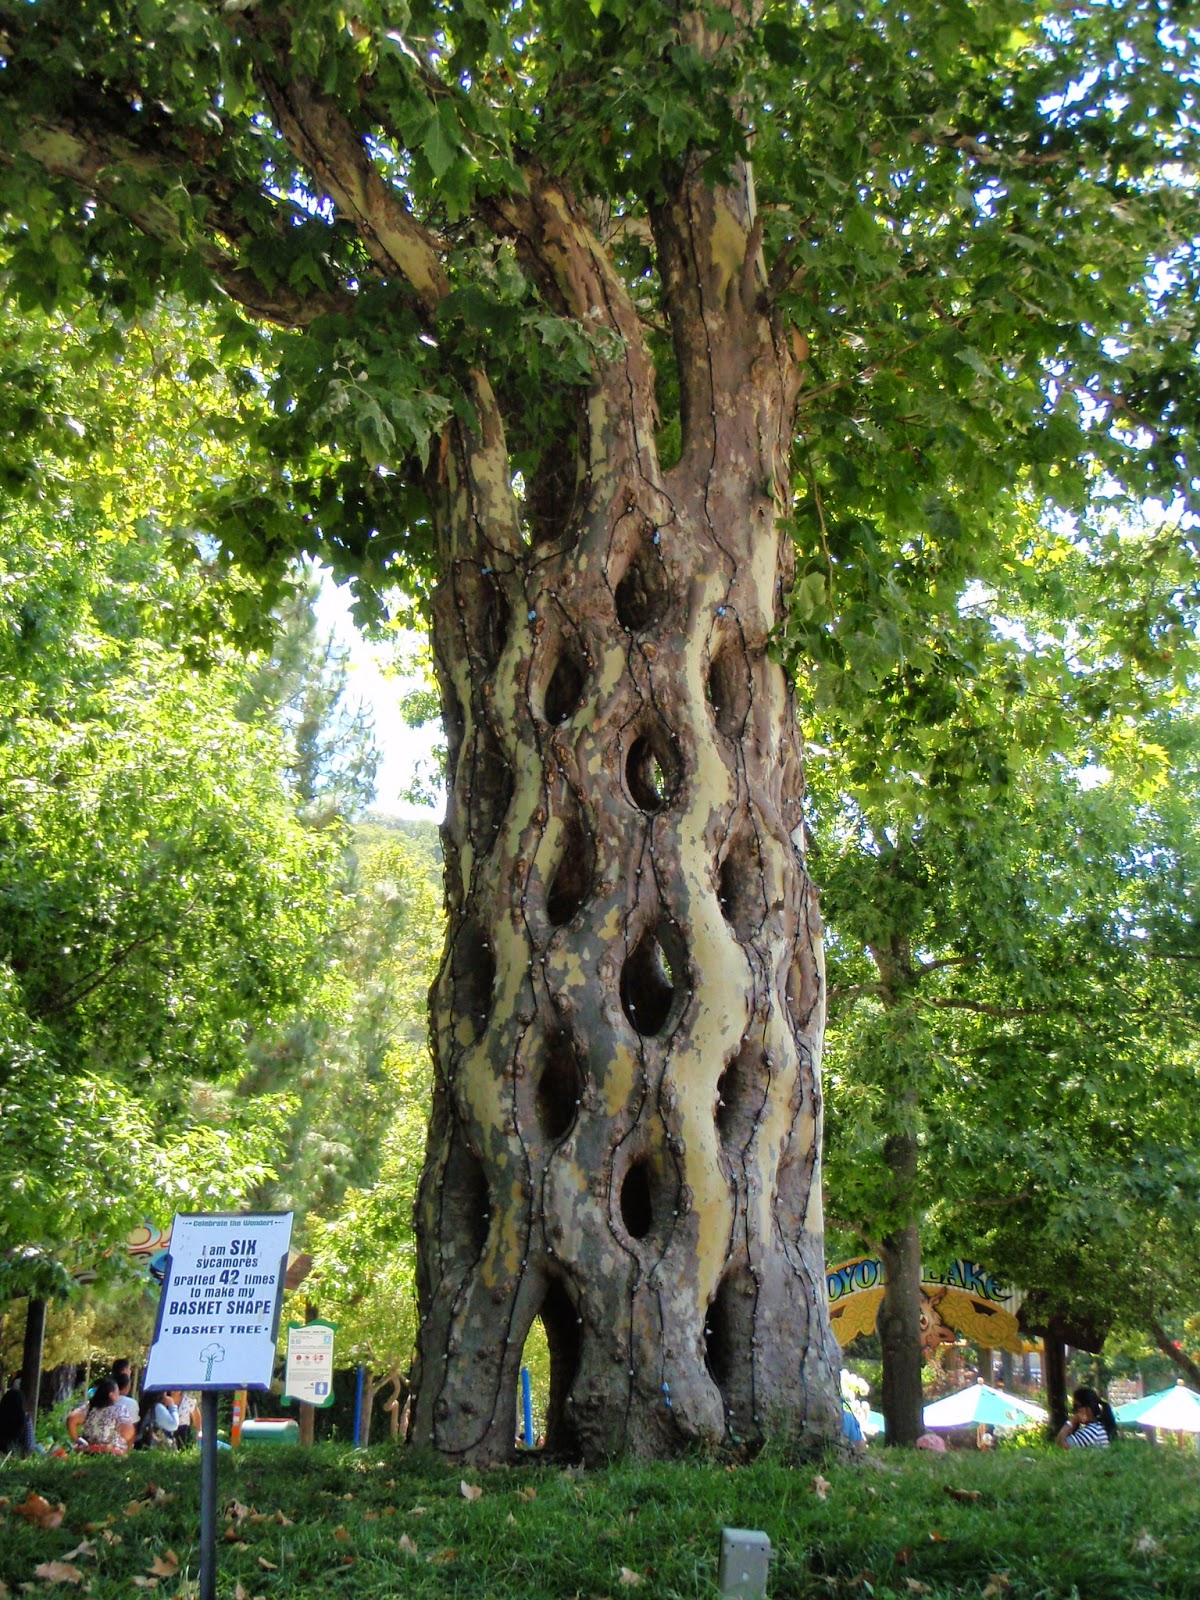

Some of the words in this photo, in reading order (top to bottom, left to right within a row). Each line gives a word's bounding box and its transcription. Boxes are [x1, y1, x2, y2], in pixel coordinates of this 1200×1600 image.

[209, 1246, 226, 1256] am
[230, 1239, 257, 1255] SIX
[196, 1258, 258, 1269] sycamores
[174, 1275, 215, 1286] grafted
[219, 1269, 240, 1285] 42
[244, 1274, 275, 1285] times
[826, 1259, 886, 1302] OYO
[190, 1287, 201, 1298] to
[204, 1287, 234, 1298] make
[238, 1288, 255, 1298] my
[169, 1301, 222, 1315] BASKET
[226, 1300, 271, 1314] SHAPE
[172, 1326, 224, 1335] BASKET
[229, 1325, 262, 1334] TREE
